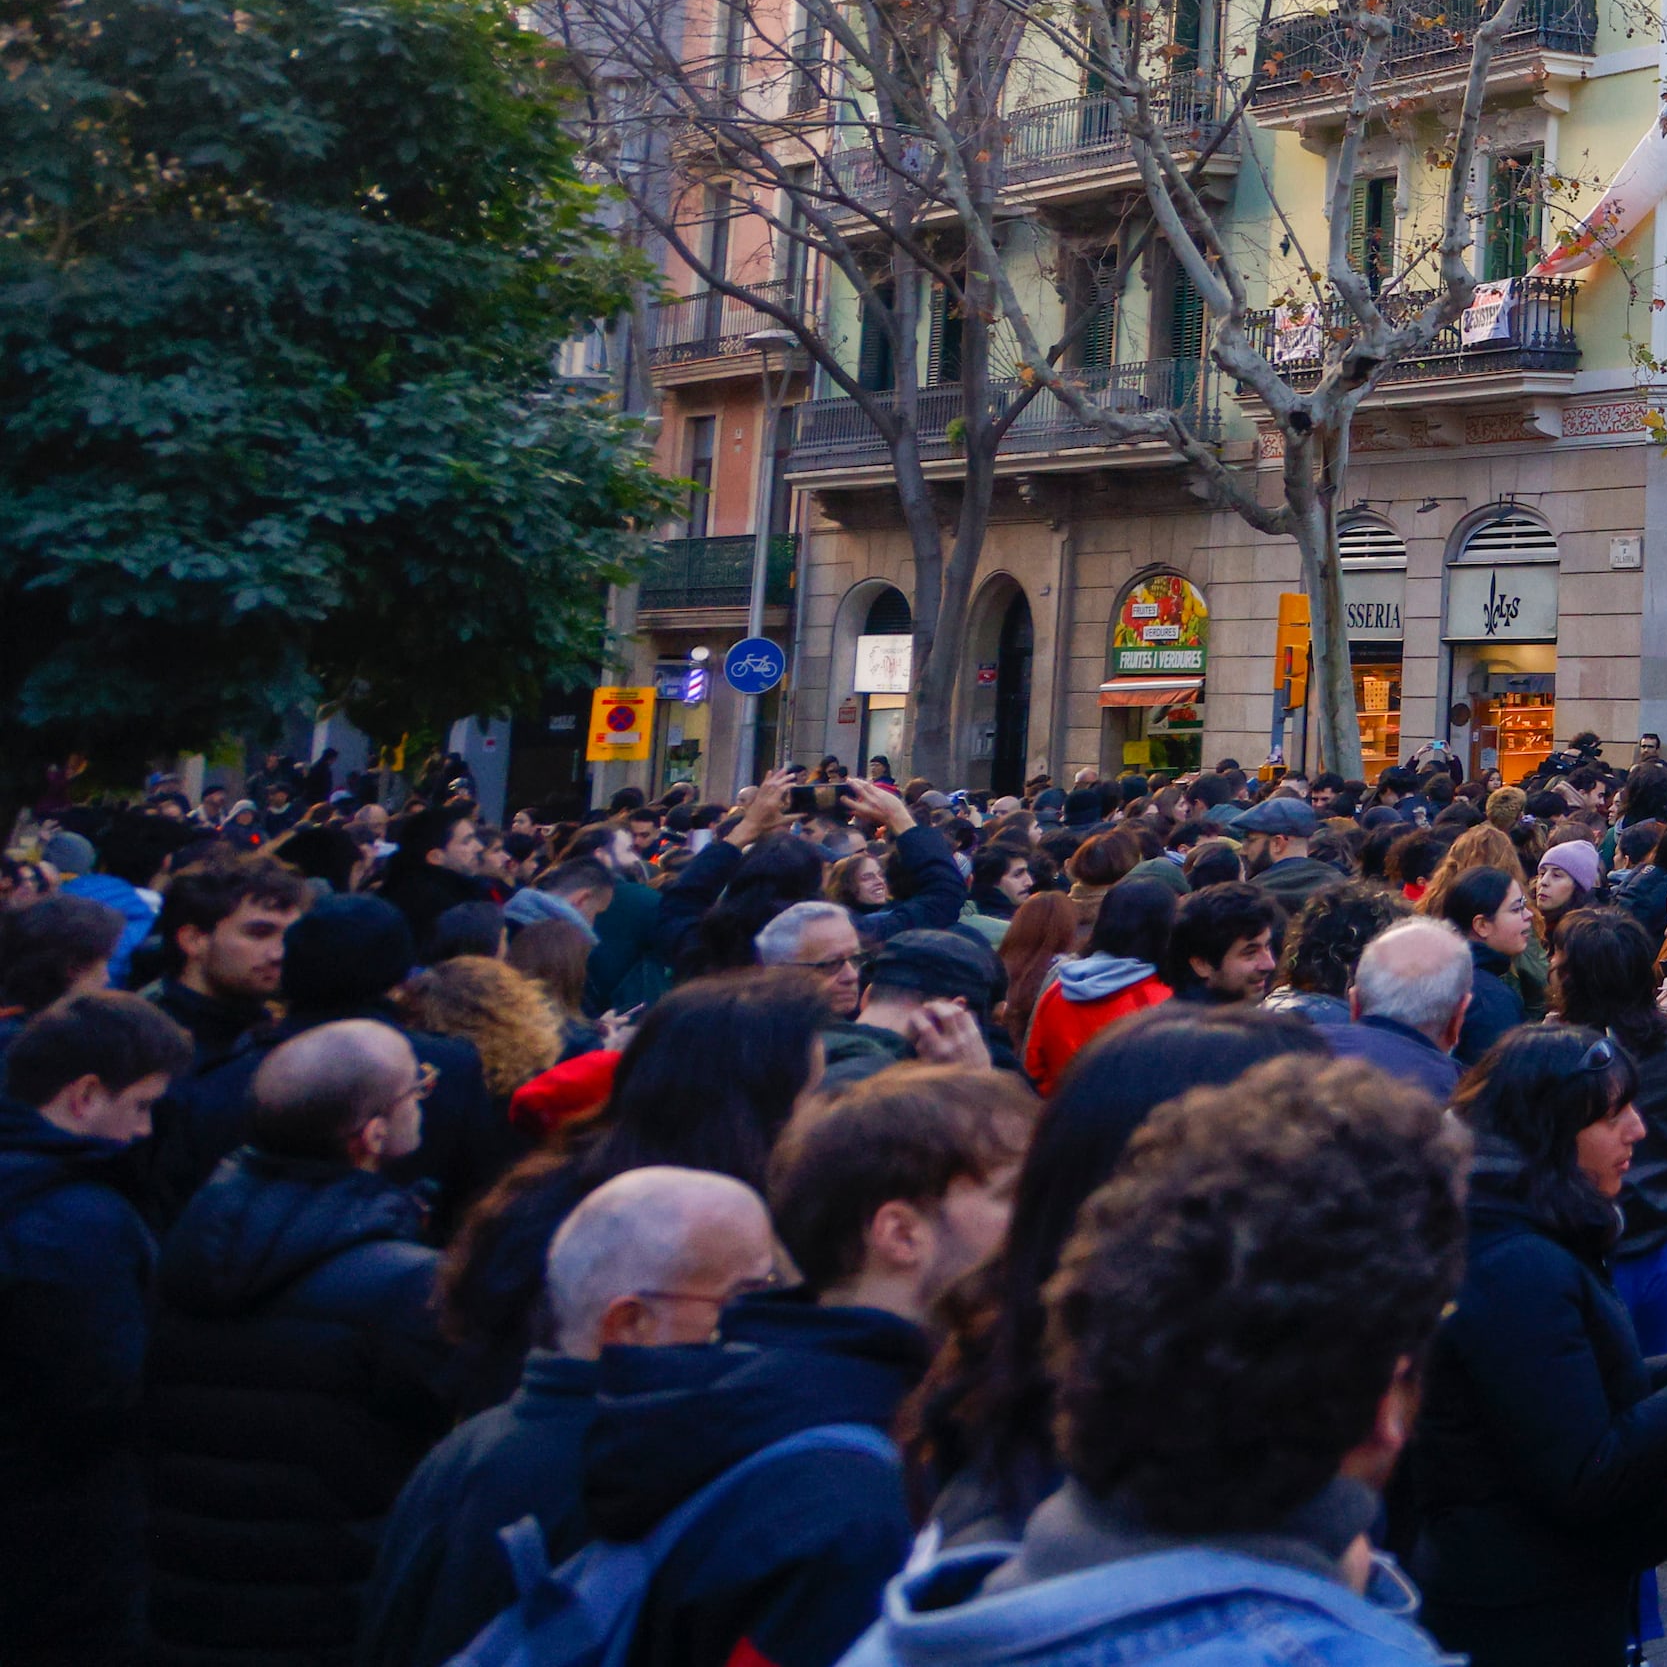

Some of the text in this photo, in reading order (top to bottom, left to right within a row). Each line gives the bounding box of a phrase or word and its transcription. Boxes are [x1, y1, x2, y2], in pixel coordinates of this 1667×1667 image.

[1133, 605, 1157, 615] FRUITES
[1145, 626, 1177, 637] VERDURES
[1120, 651, 1152, 669] FRUITES
[1159, 650, 1203, 669] VERDURES
